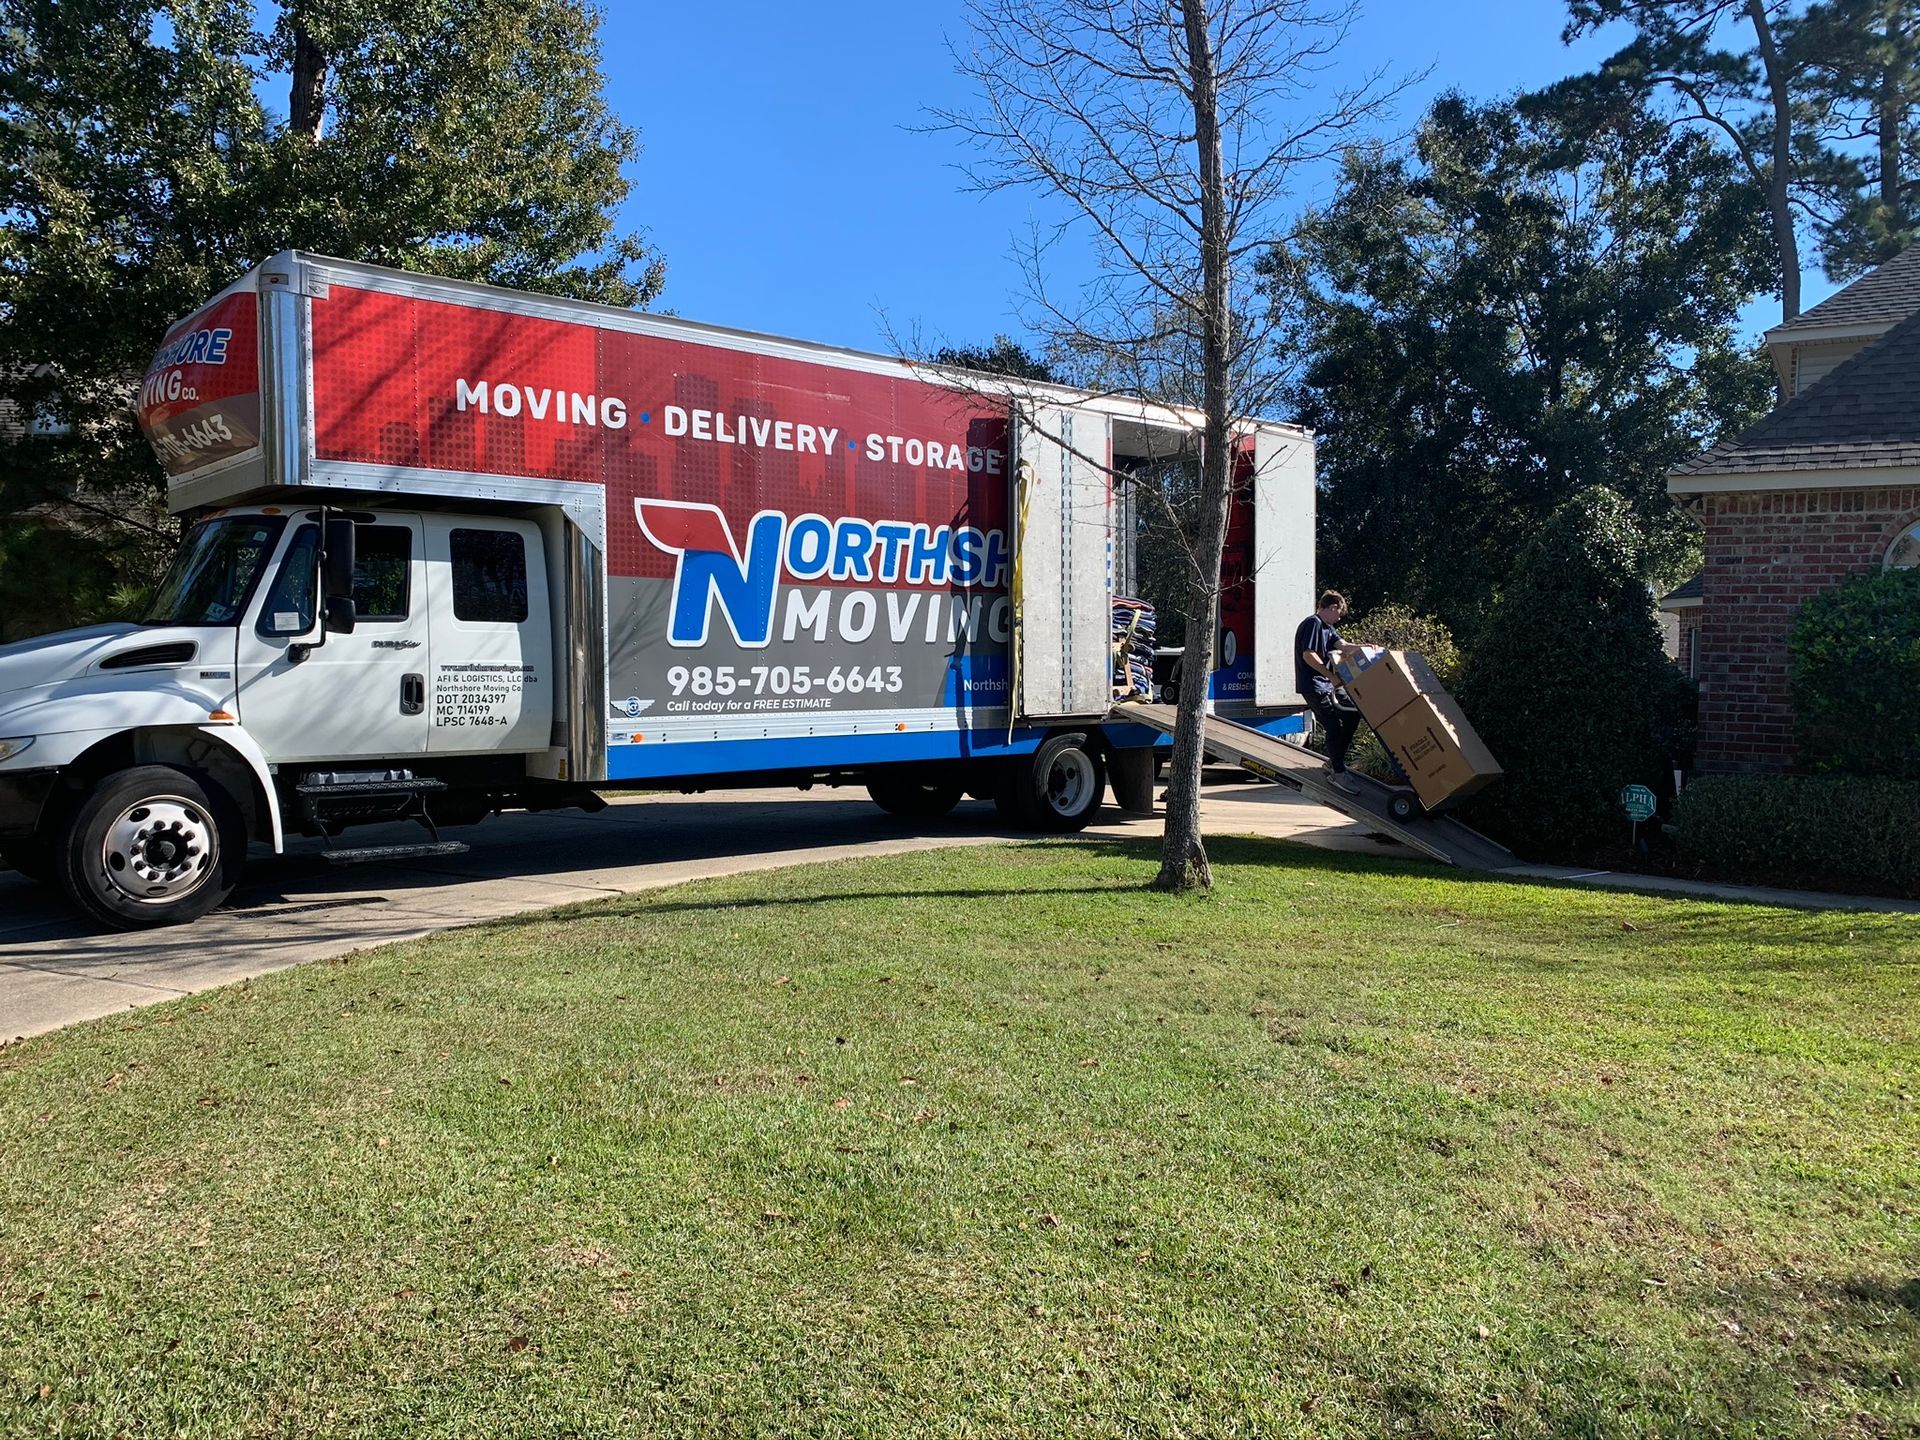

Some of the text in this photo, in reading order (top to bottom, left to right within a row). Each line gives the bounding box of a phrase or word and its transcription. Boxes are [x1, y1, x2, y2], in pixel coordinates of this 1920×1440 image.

[181, 387, 199, 400] CO.
[456, 378, 1001, 476] MOVING DELIVERY STORAGE
[782, 588, 1009, 644] MOVING
[461, 675, 505, 683] LOGISTICS,
[667, 665, 903, 696] 985-705-6643
[483, 685, 510, 693] Moving
[436, 694, 506, 704] DOT 2034397
[436, 705, 490, 715] MC 714199
[667, 698, 832, 714] Call today for a FREE ESTIMATE
[436, 716, 508, 726] LPSC 7648-A
